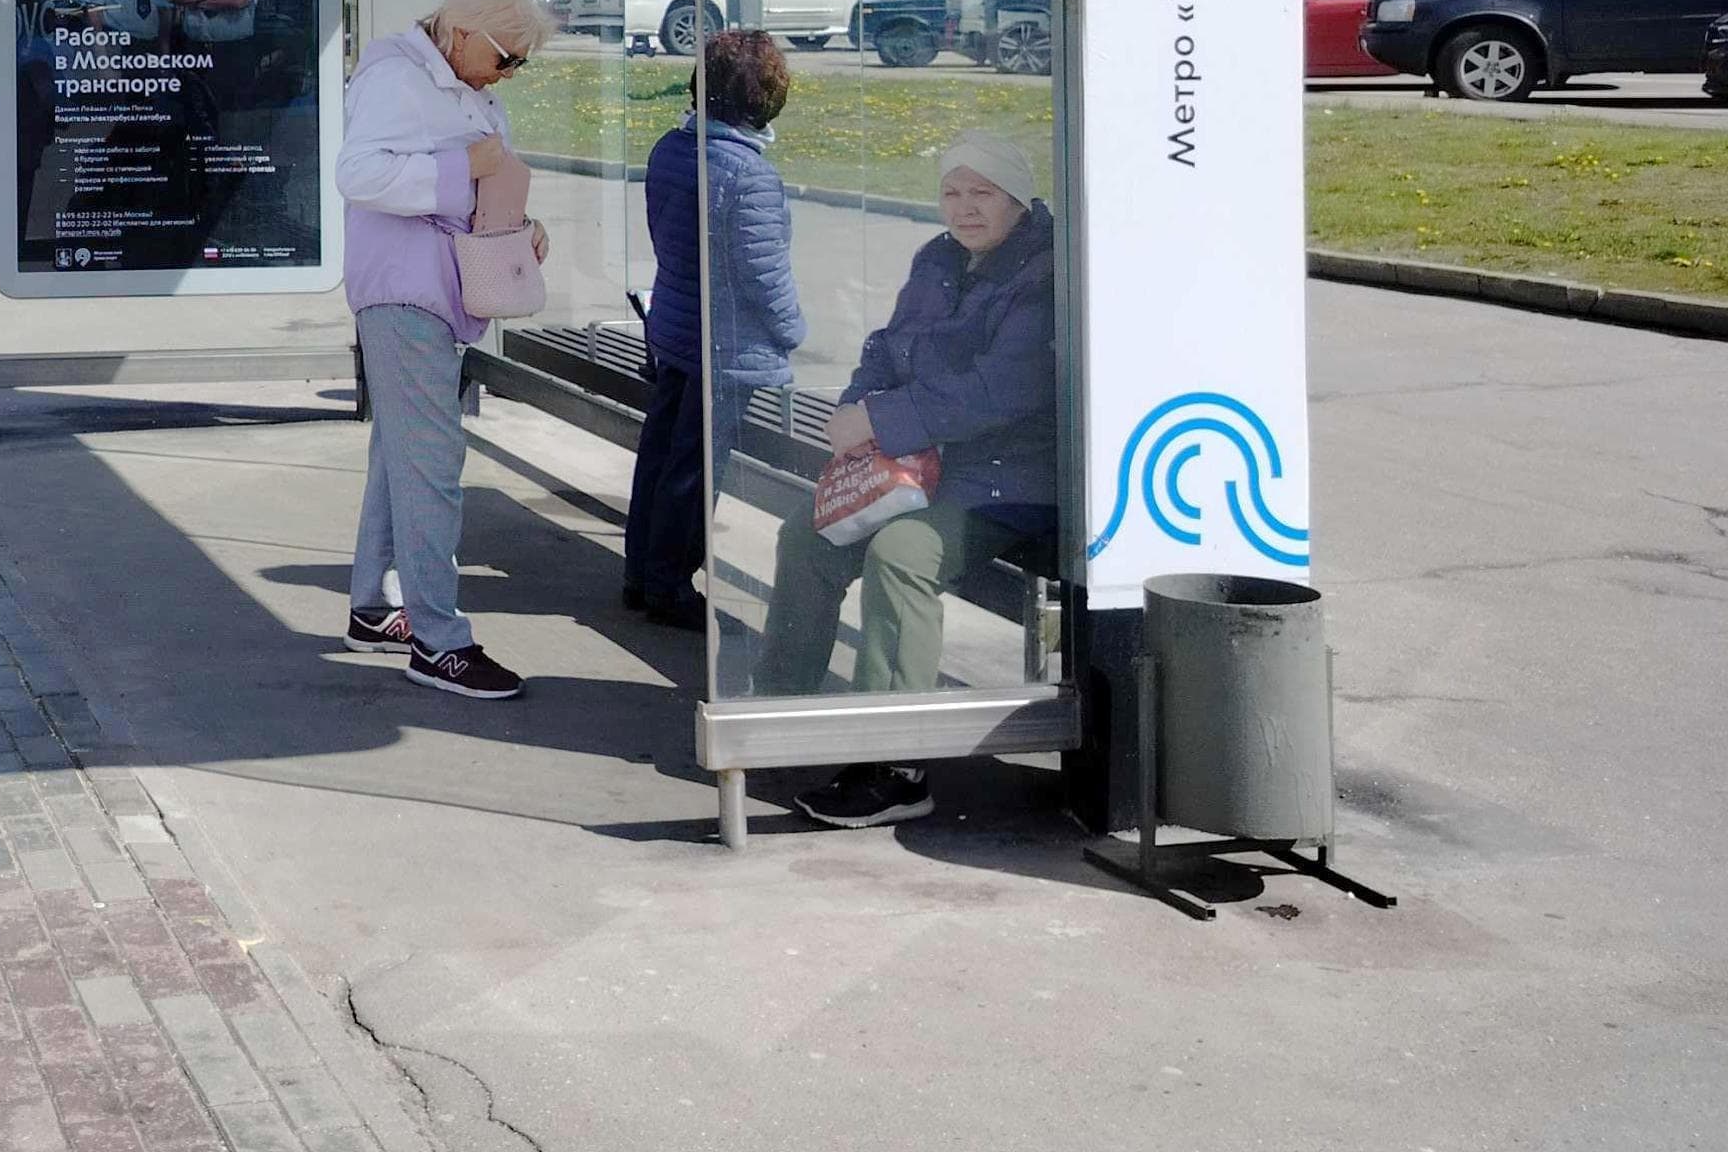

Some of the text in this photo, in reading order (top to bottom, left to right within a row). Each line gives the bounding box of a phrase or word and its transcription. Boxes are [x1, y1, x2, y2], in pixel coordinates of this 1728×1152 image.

[55, 26, 132, 47] Работа
[55, 51, 214, 70] в Московском
[54, 77, 182, 97] транспорте
[1167, 35, 1202, 168] Метро
[55, 115, 90, 123] Водитель
